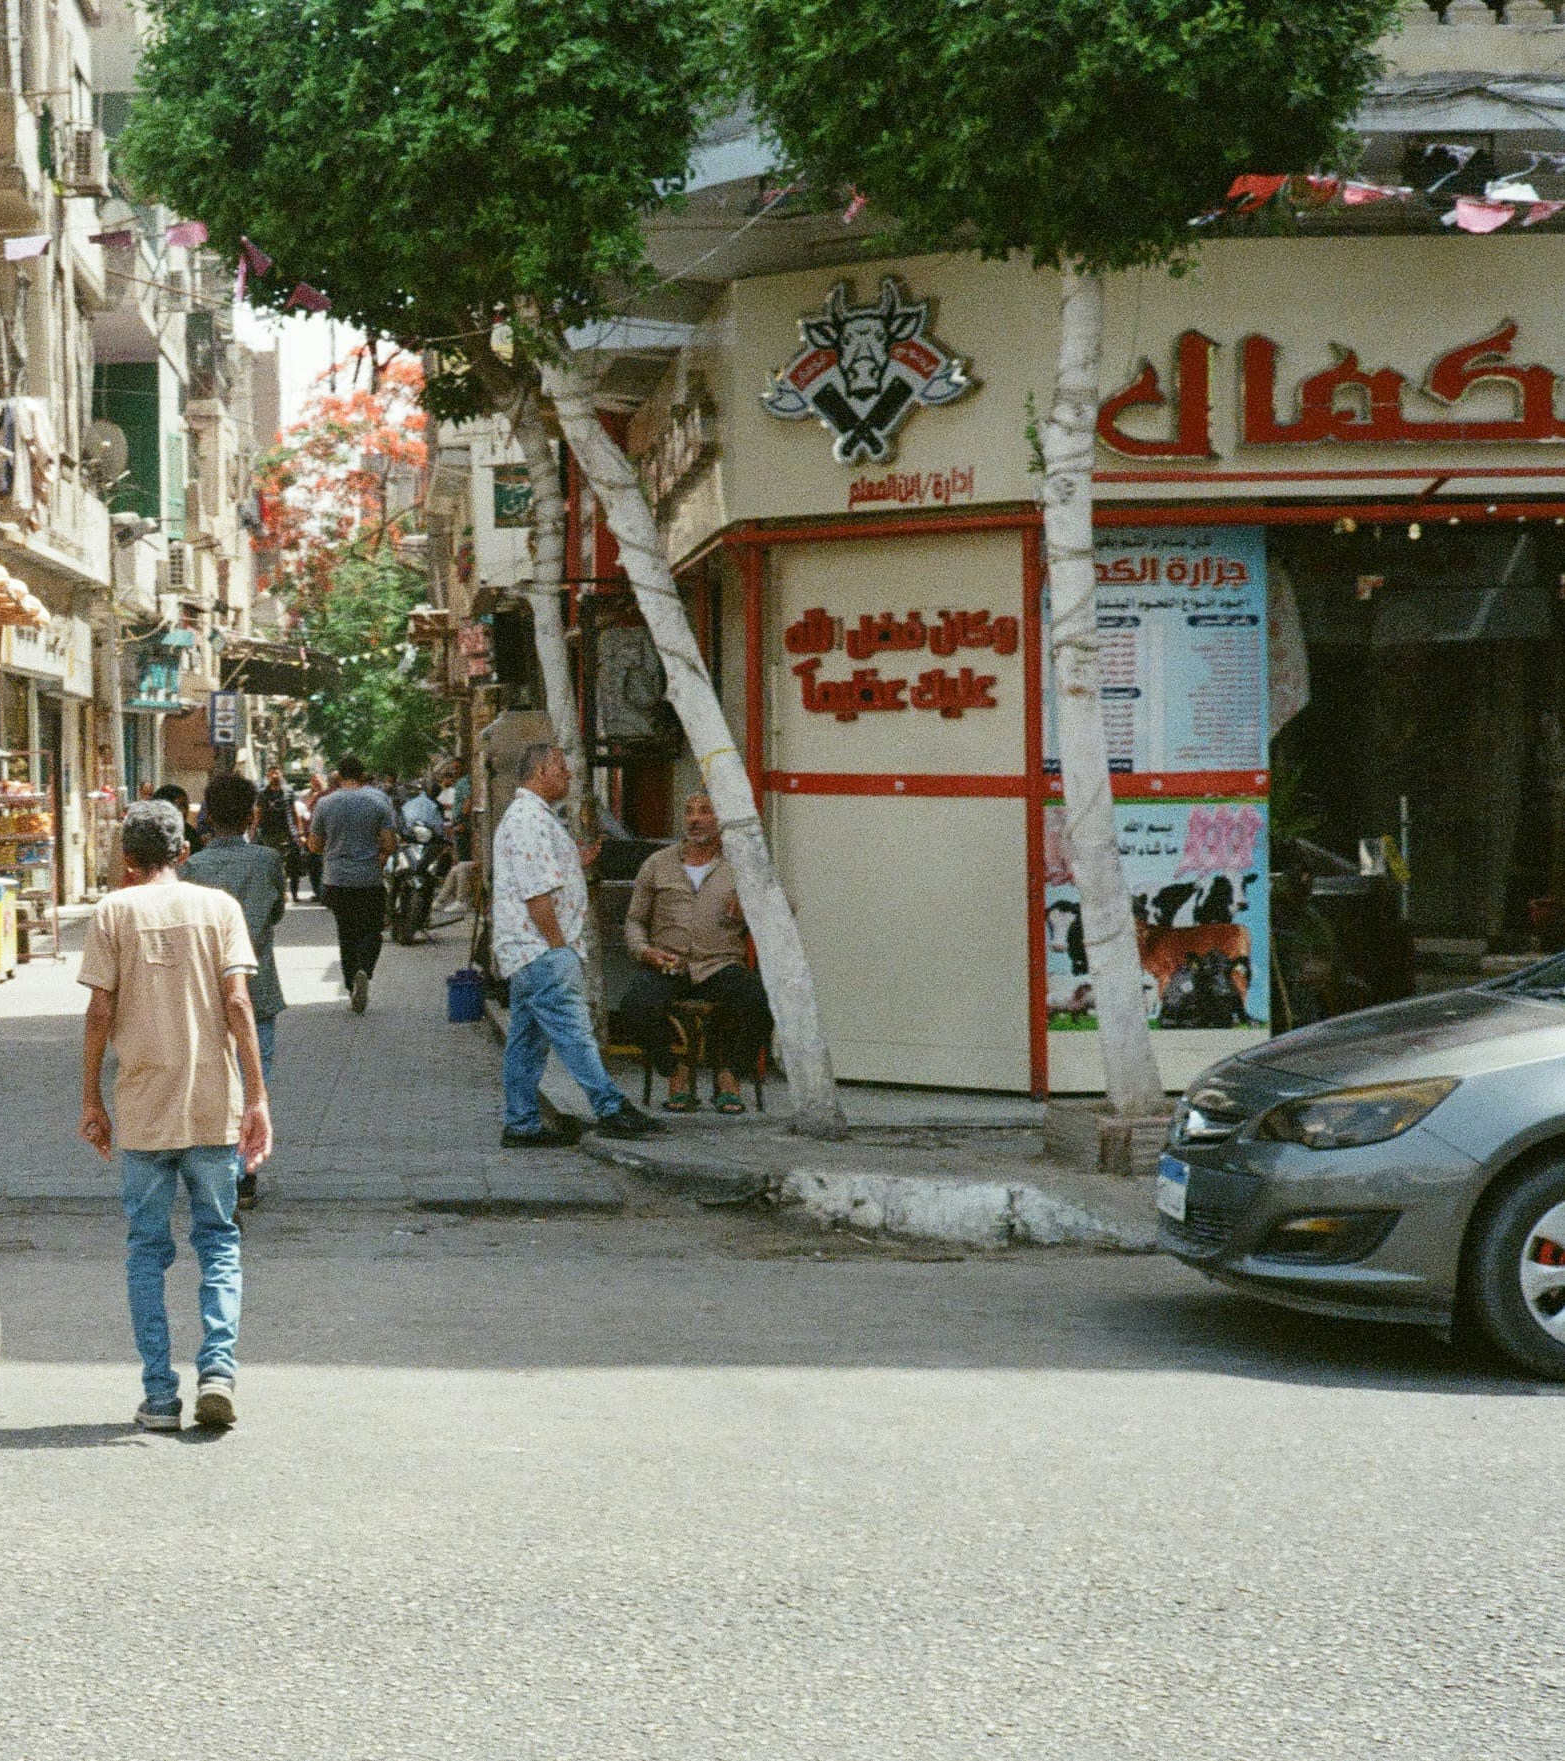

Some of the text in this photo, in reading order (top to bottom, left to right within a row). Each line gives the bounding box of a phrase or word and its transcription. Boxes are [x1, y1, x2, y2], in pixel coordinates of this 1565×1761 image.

[1096, 317, 1565, 459] كمال
[1094, 555, 1249, 590] جزارة الكم
[784, 607, 1018, 660] وكان فضل الله
[910, 667, 997, 719] عليك
